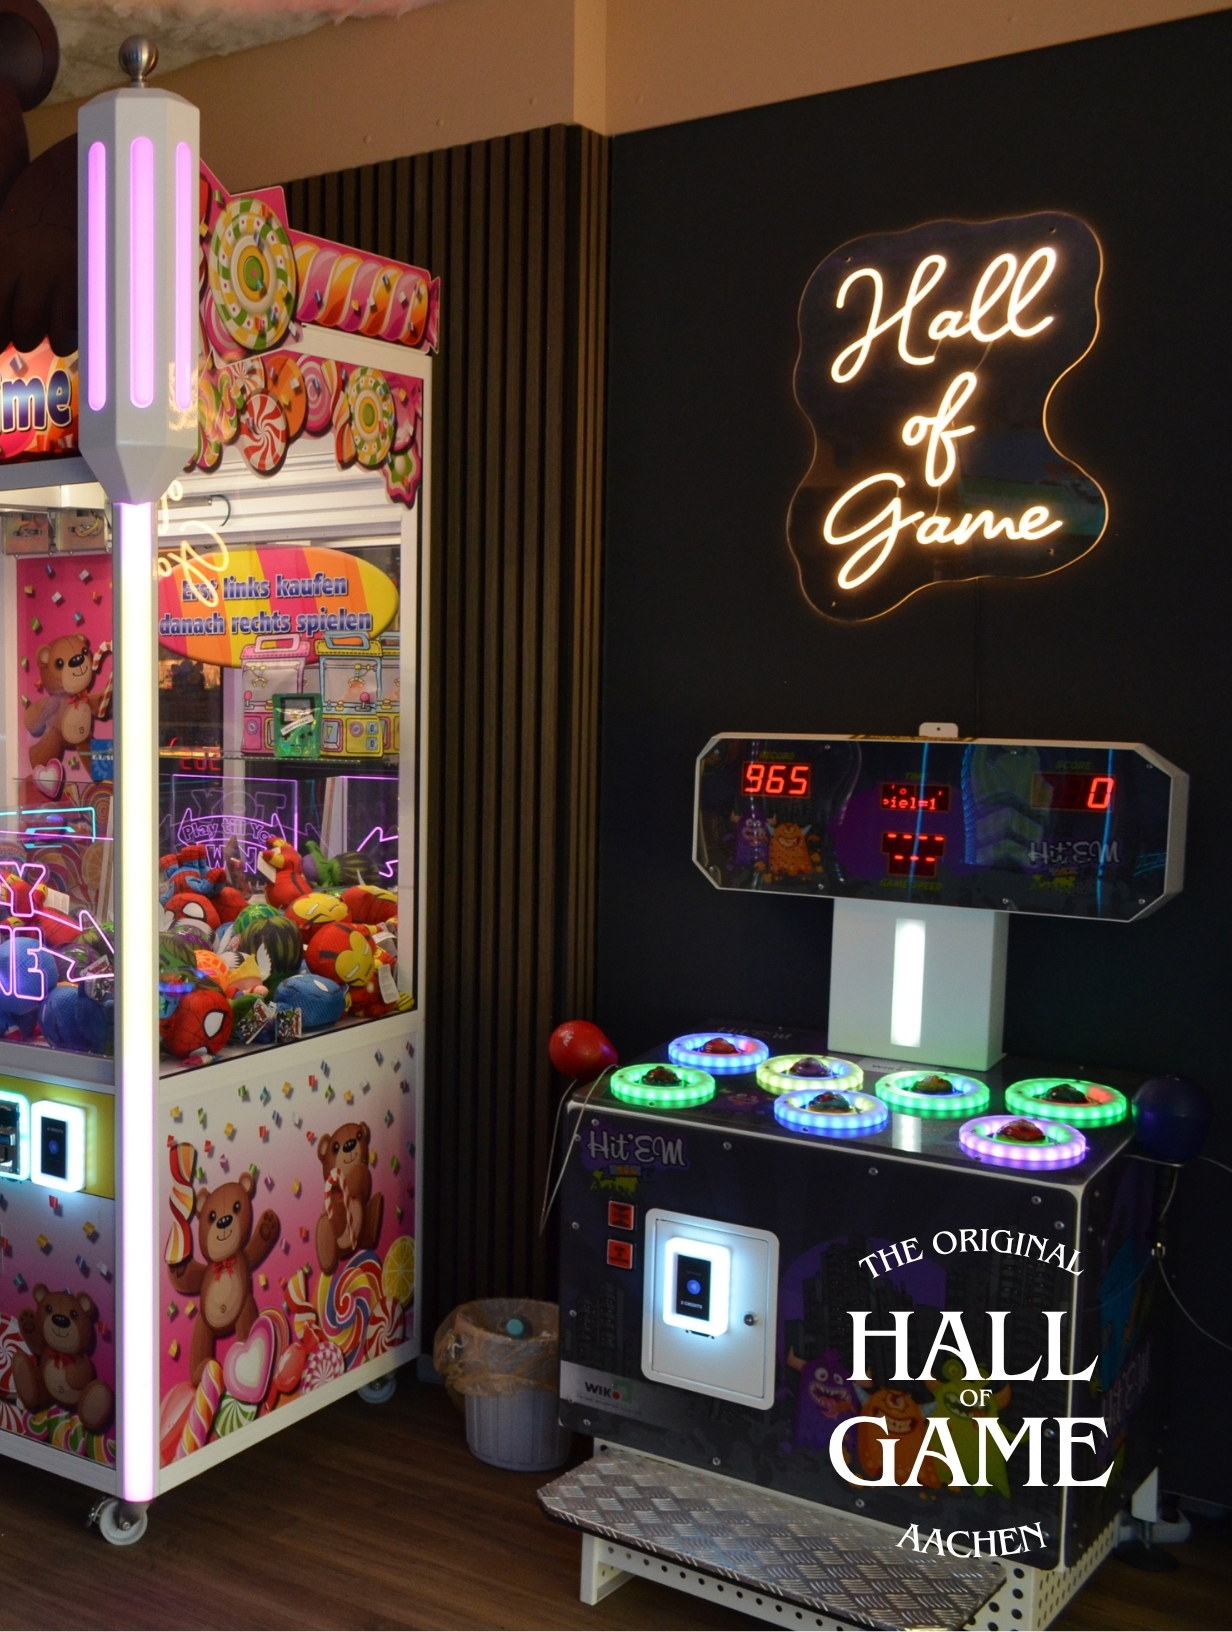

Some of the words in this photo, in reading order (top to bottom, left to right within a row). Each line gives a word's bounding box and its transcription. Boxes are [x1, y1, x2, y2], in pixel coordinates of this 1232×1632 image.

[831, 246, 1057, 384] Hall
[902, 371, 977, 488] of
[823, 472, 1063, 590] Game
[181, 578, 219, 601] Erst
[223, 575, 270, 600] links
[276, 572, 348, 599] kaufen
[159, 613, 225, 636] danach
[231, 610, 290, 634] rechts
[297, 608, 373, 636] spielen
[743, 763, 810, 796] 965
[1086, 777, 1115, 810] 0
[182, 823, 218, 841] Play
[250, 822, 278, 843] Yo
[205, 843, 257, 875] WN
[587, 1130, 687, 1167] Hit'EM
